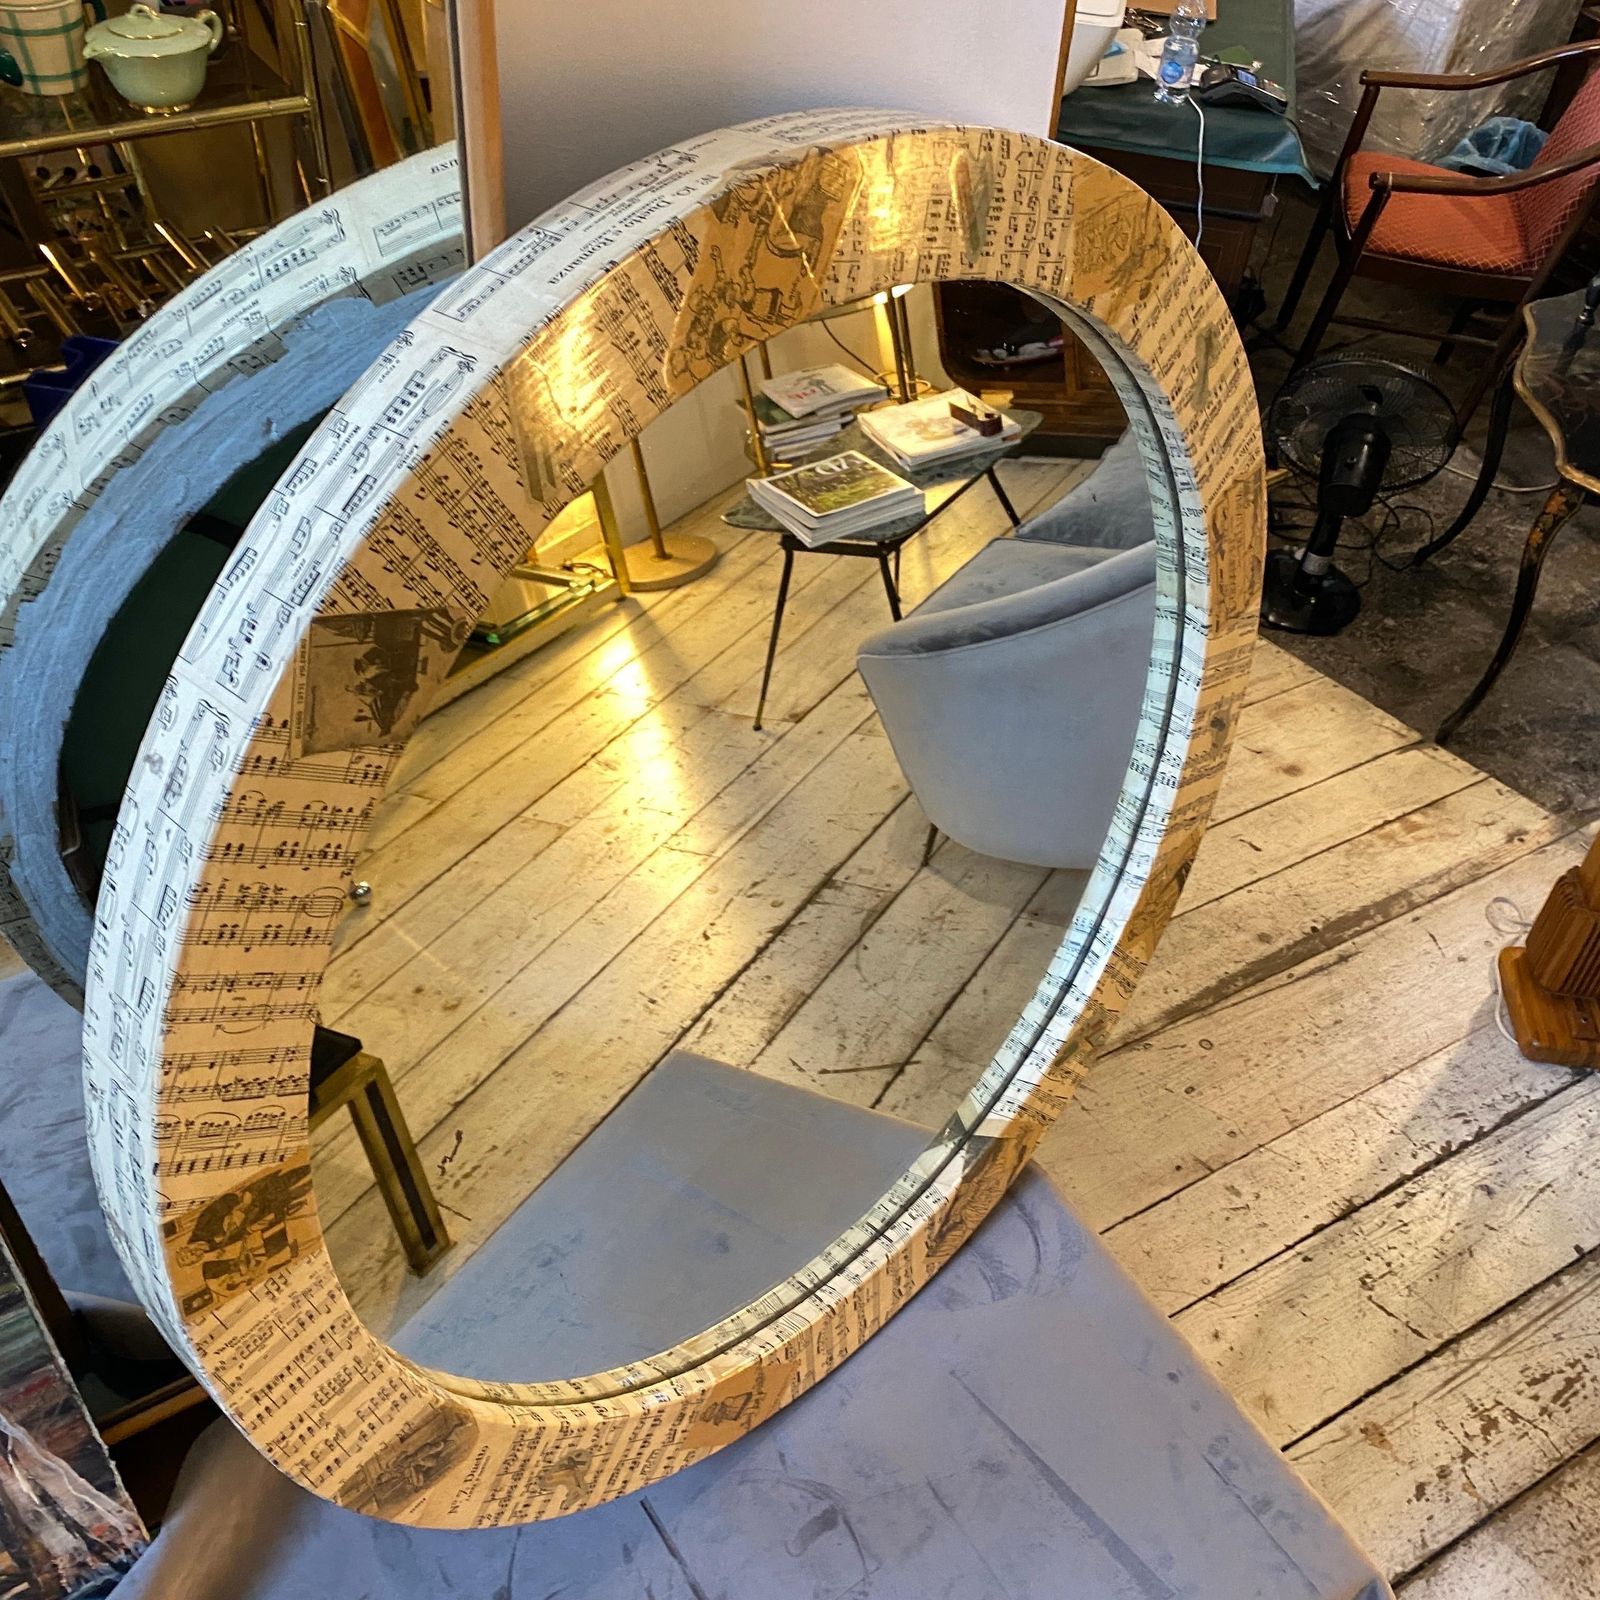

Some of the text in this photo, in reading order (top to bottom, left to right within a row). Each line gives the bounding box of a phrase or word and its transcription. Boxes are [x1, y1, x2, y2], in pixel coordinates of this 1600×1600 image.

[624, 200, 673, 228] Duetto
[547, 236, 615, 285] Romanza
[463, 1445, 488, 1482] Duetto
